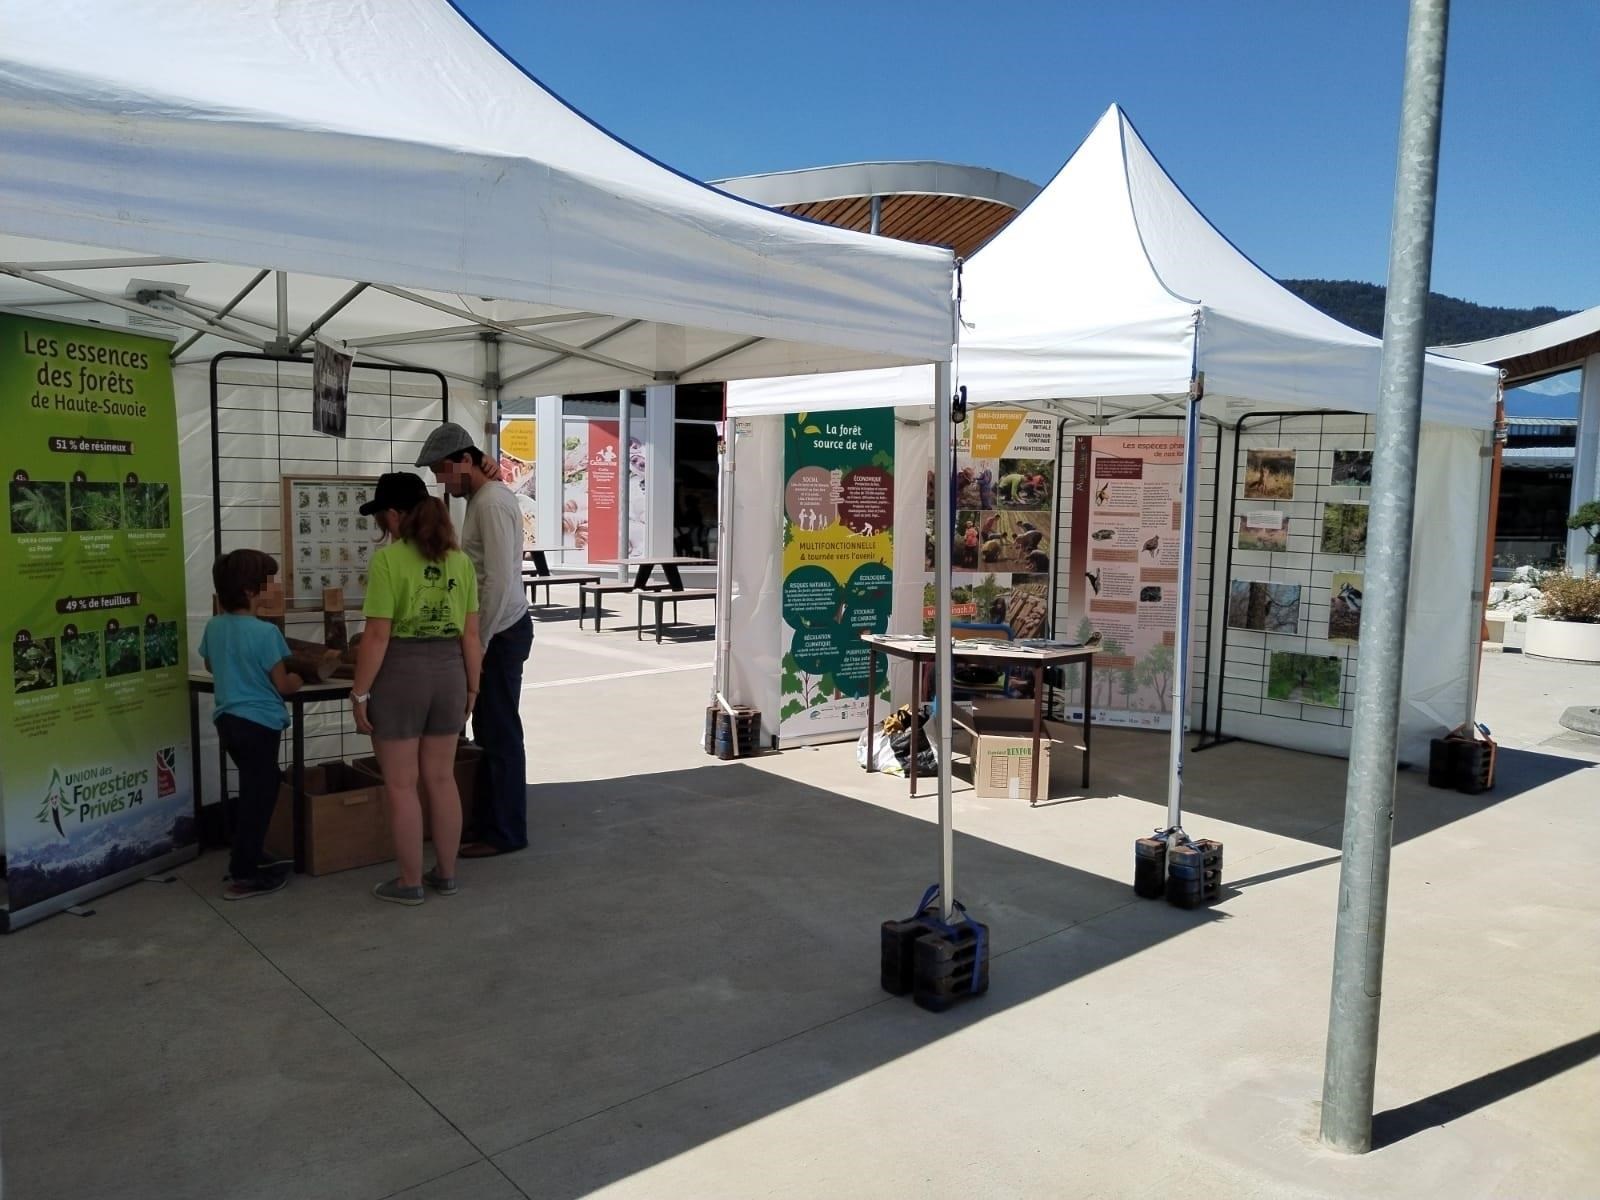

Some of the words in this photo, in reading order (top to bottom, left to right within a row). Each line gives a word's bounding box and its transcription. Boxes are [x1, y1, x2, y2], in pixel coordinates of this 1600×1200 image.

[24, 330, 58, 357] Les
[66, 343, 148, 370] essences
[37, 361, 72, 388] des
[79, 366, 134, 395] forêts
[31, 391, 49, 409] de
[55, 394, 147, 417] Haute-Savoie
[826, 424, 837, 435] La
[840, 424, 862, 437] forêt
[56, 439, 67, 450] 51
[69, 440, 78, 450] %
[79, 440, 90, 451] de
[91, 441, 126, 453] résineux
[813, 440, 844, 450] source
[846, 440, 857, 450] de
[860, 441, 873, 451] vie
[1138, 442, 1167, 450] espèces
[800, 541, 876, 551] MULTIFONCTIONNELLE
[807, 553, 835, 561] tournée
[851, 552, 876, 560] l'avenir
[66, 601, 77, 610] 49
[79, 600, 87, 609] %
[89, 598, 99, 608] de
[101, 595, 131, 607] feuillus
[65, 767, 98, 787] UNION
[99, 766, 113, 778] des
[73, 769, 149, 804] Forestiers
[80, 794, 125, 823] Privés
[128, 789, 144, 810] 74
